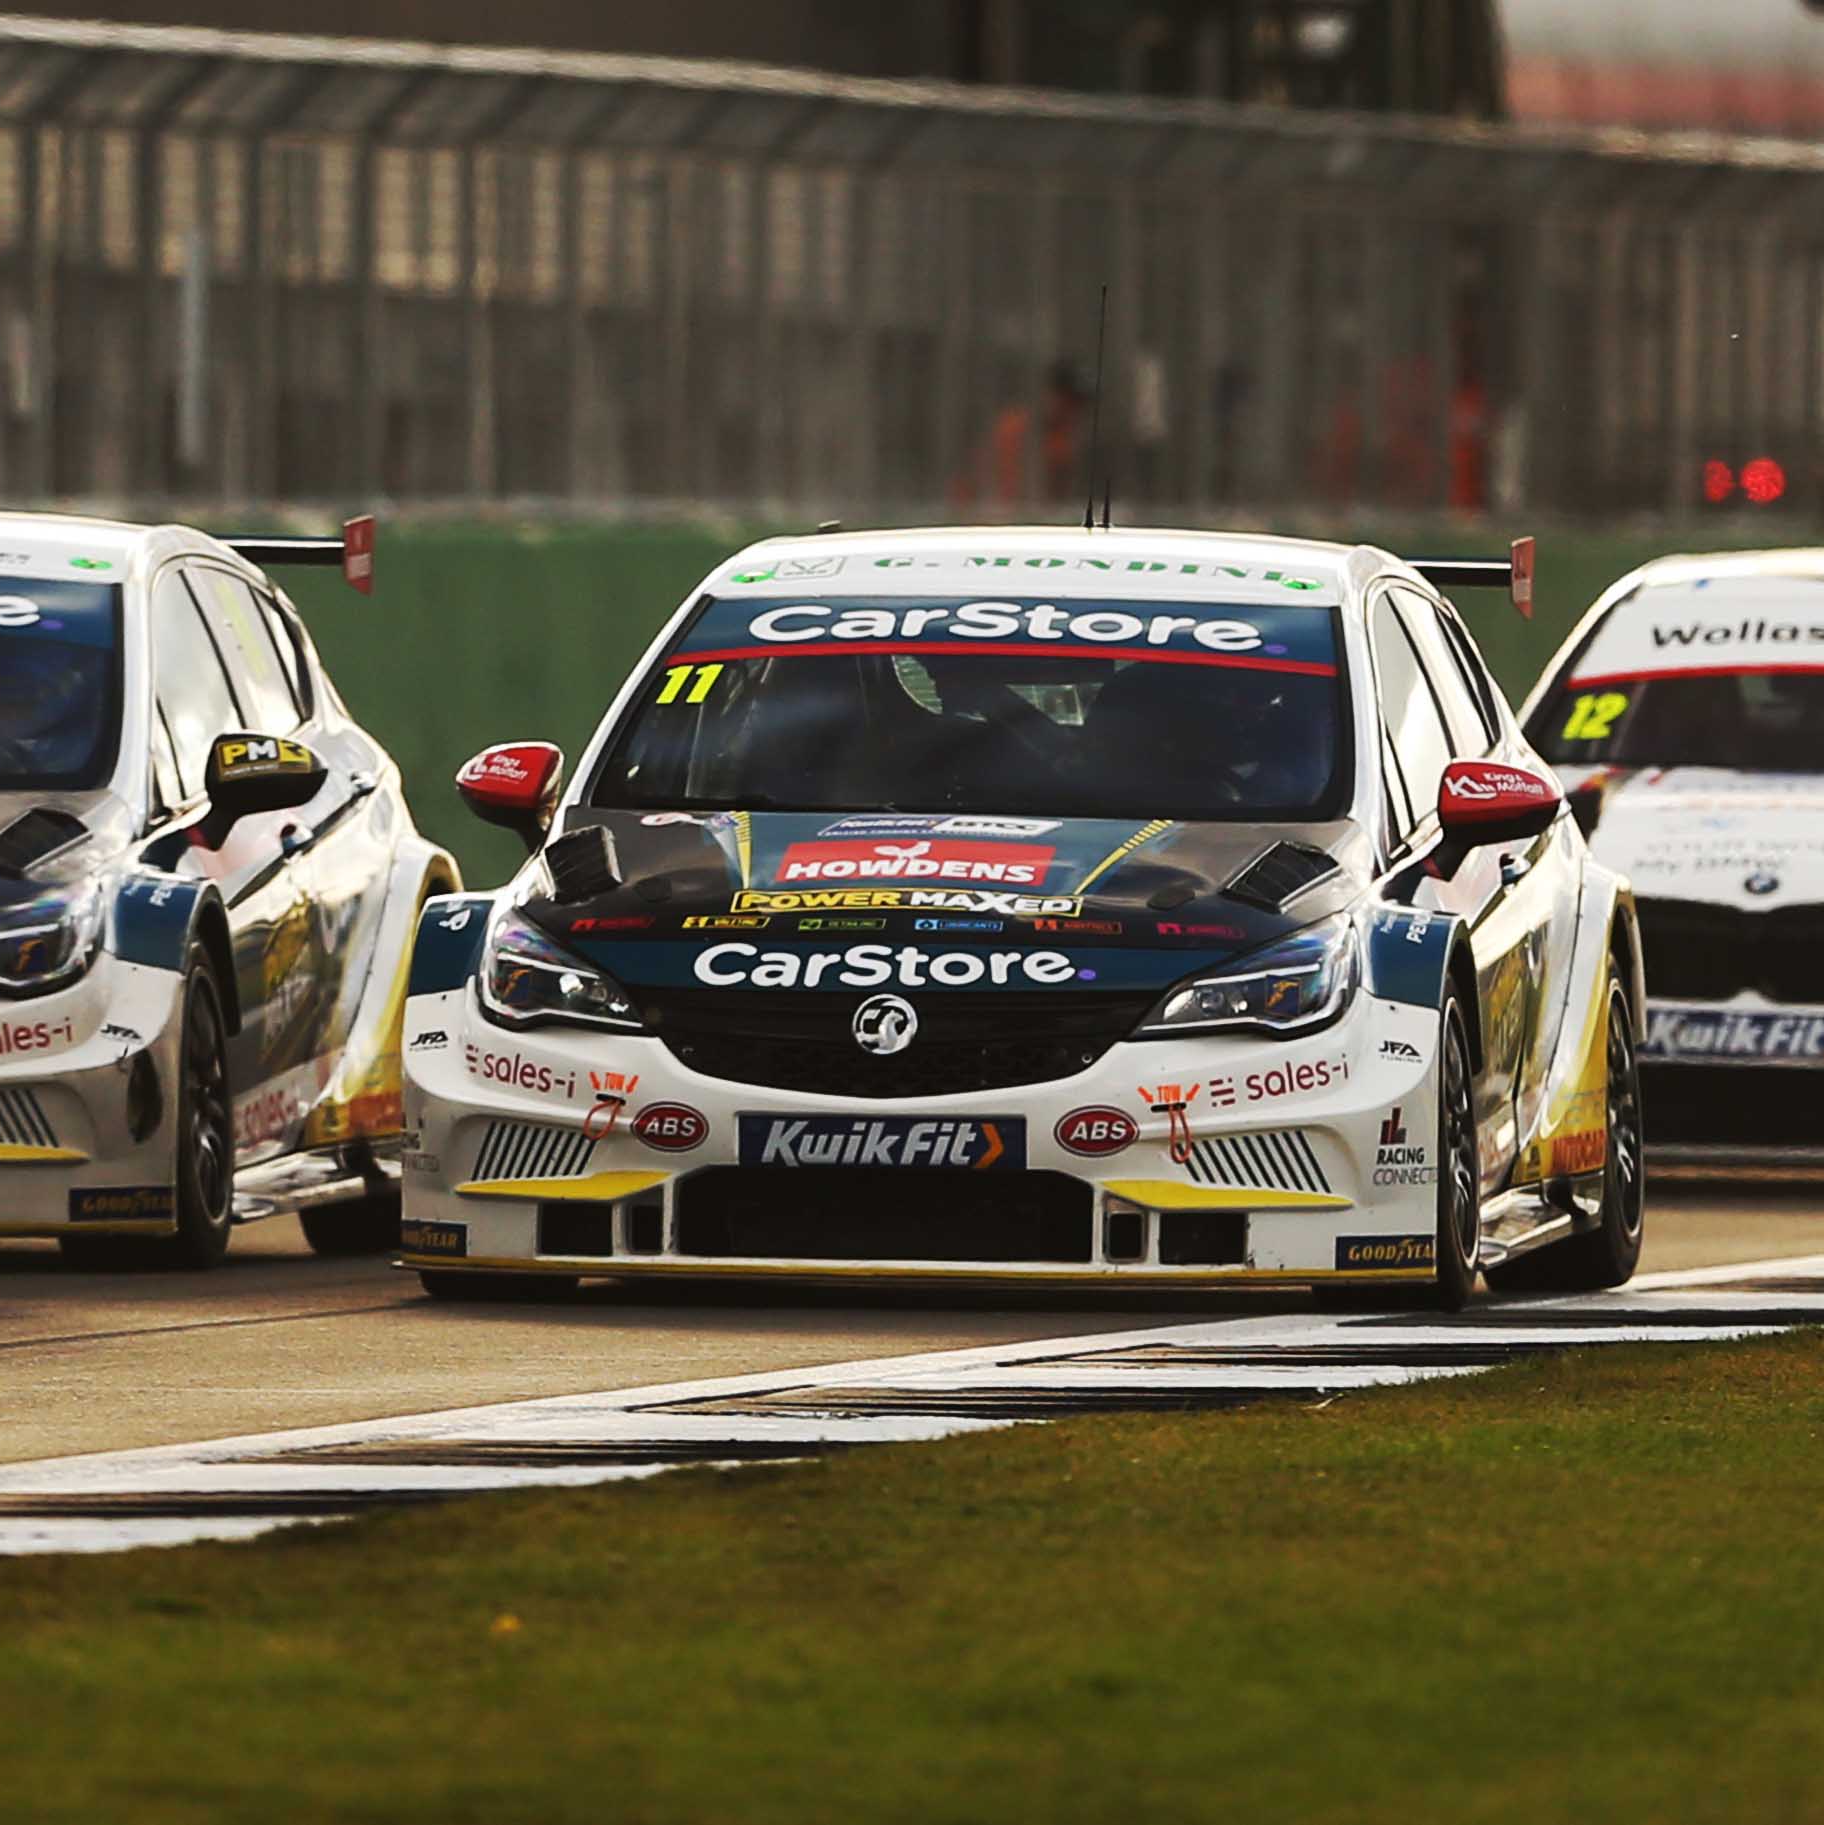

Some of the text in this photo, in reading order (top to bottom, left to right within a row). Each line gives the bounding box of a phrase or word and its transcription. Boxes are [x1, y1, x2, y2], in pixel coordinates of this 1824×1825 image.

[655, 664, 724, 705] 11
[1562, 693, 1628, 740] 12
[784, 858, 1036, 883] HOWDENS
[740, 891, 902, 909] POWER
[482, 1049, 576, 1099] sales-i
[1244, 1053, 1350, 1102] sales-i
[643, 1115, 697, 1138] ABS
[1068, 1119, 1128, 1141] ABS
[1376, 1148, 1425, 1166] RACING
